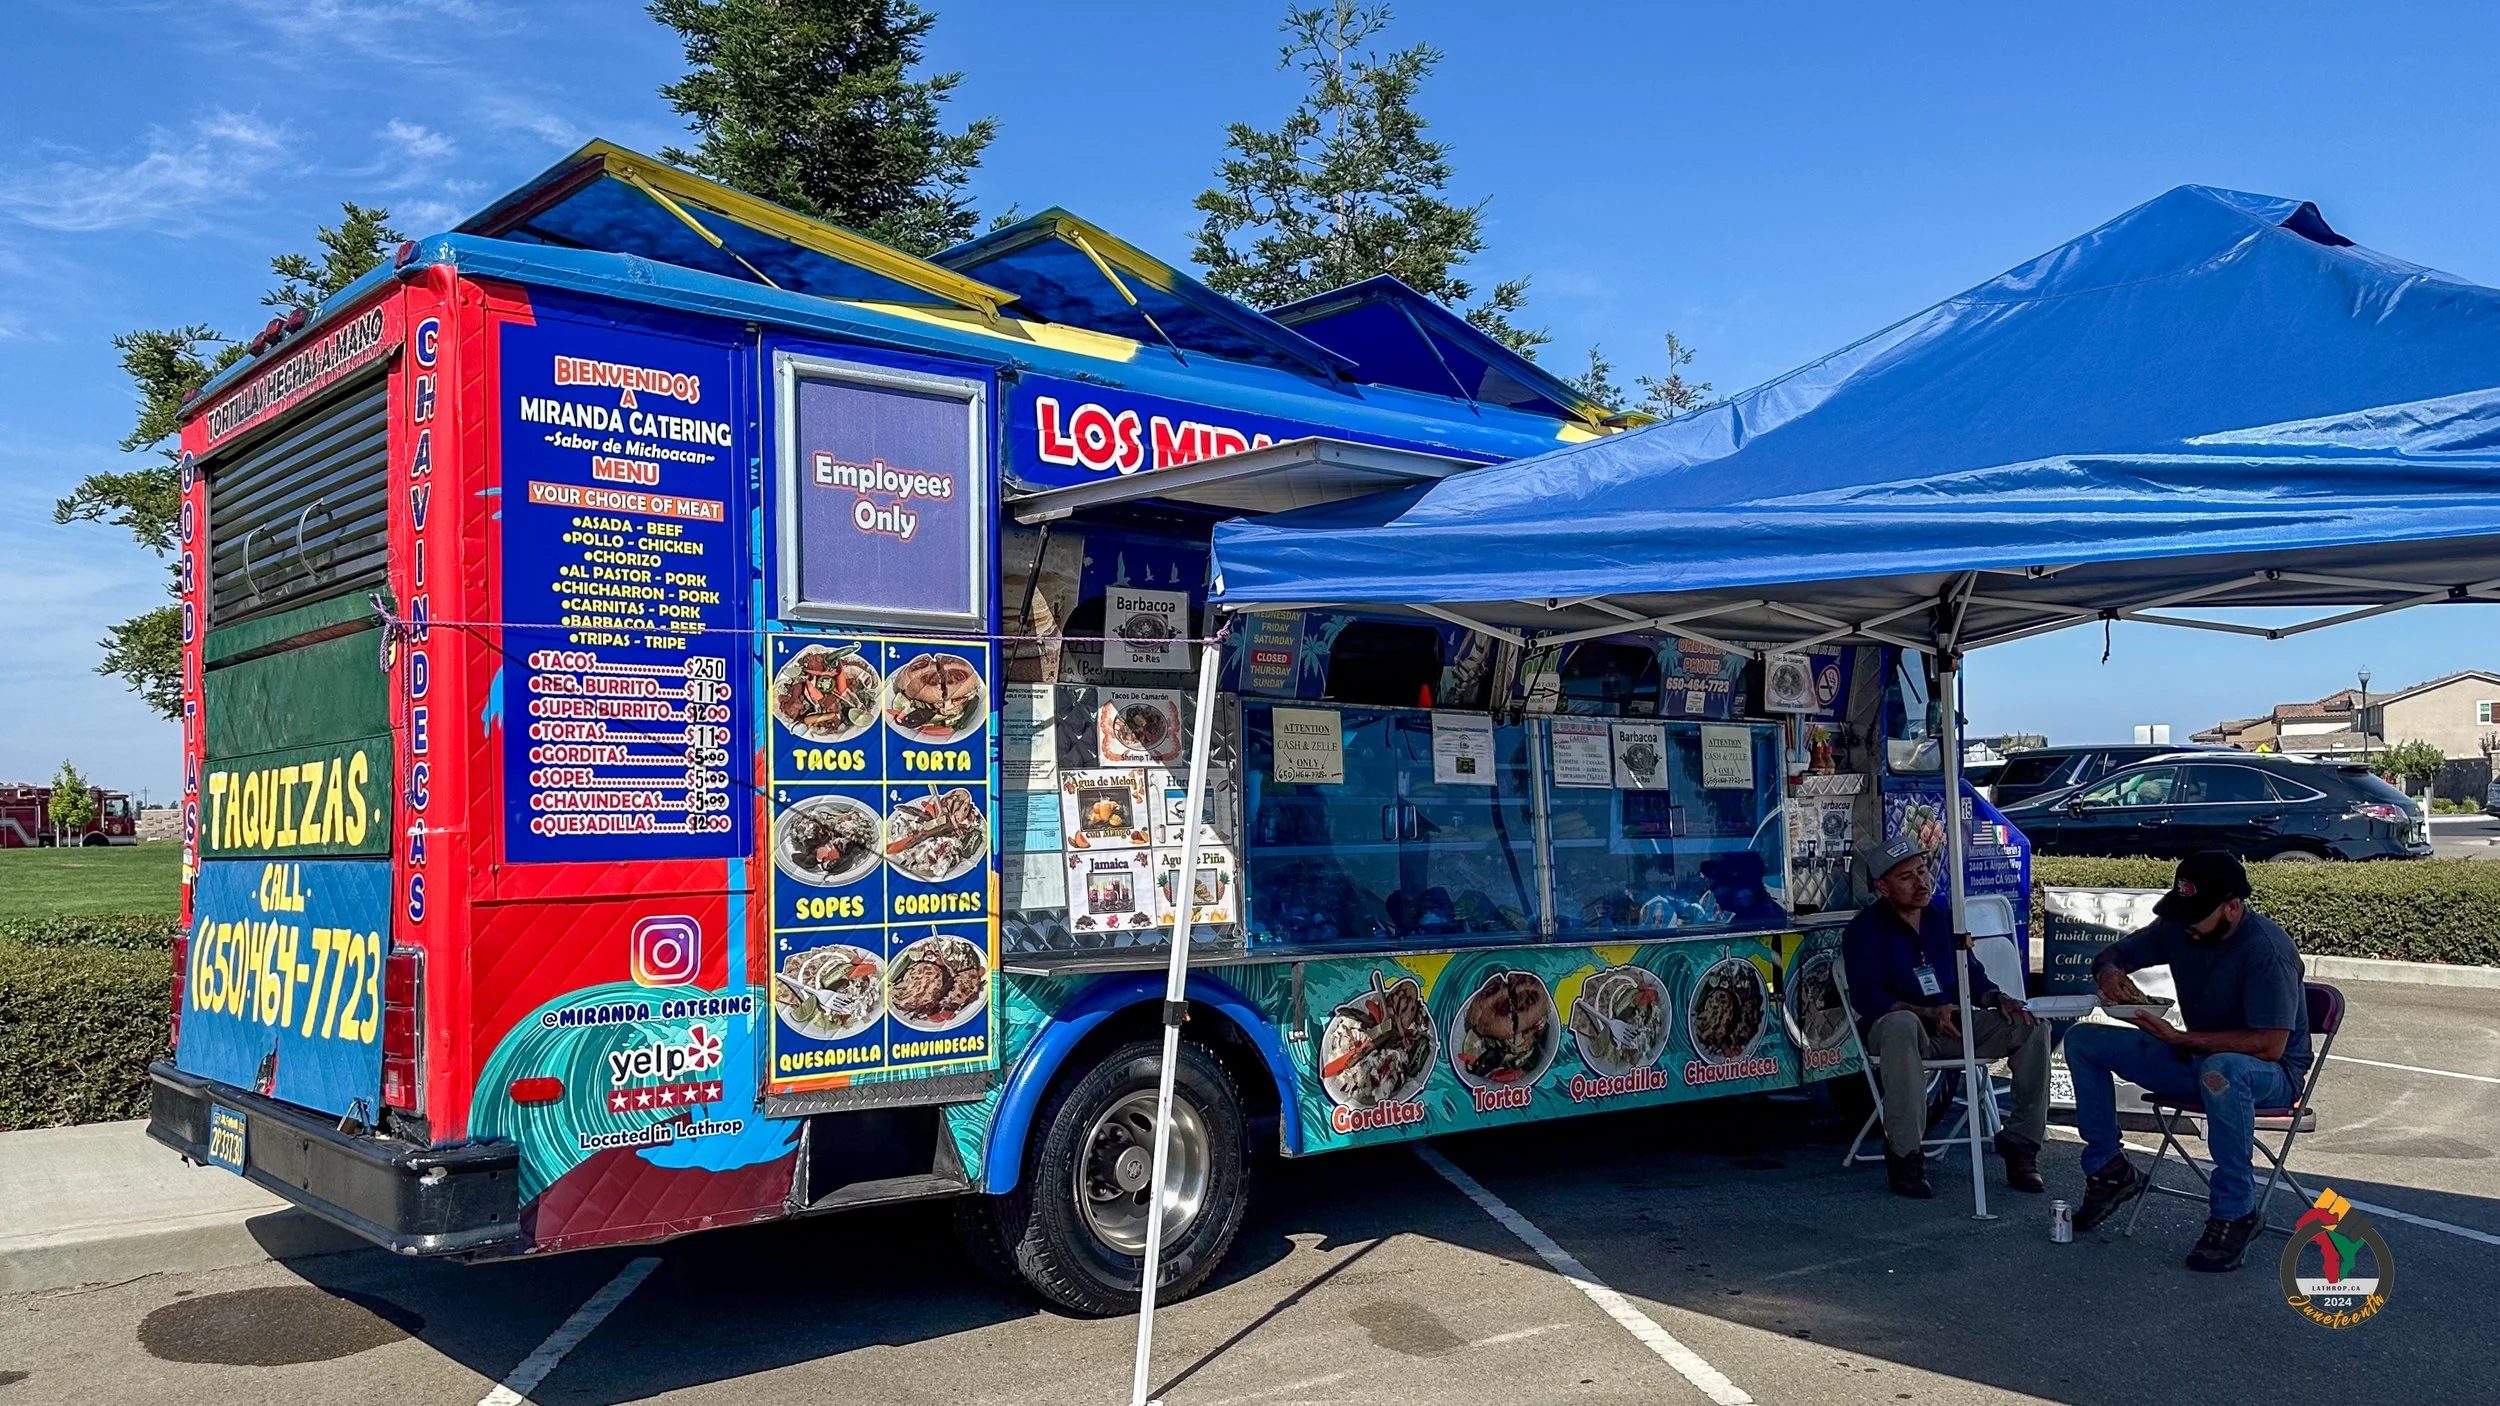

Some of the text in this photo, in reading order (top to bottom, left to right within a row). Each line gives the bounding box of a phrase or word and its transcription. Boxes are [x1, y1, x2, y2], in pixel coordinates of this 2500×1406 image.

[207, 381, 265, 443] TORTILLAS
[264, 344, 318, 405] HECHAS
[334, 305, 385, 366] MANO
[554, 355, 700, 405] BIENVENIDOS
[620, 388, 638, 409] A
[521, 396, 732, 447] MIRANDA CATERING
[1036, 395, 1144, 475] LOS
[602, 437, 622, 454] de
[592, 455, 660, 486] MENU
[814, 453, 952, 499] Employees
[532, 484, 720, 519] YOUR CHOICE OF MEAT
[582, 516, 683, 537] ASADA BEEF
[854, 501, 916, 538] Only
[571, 531, 704, 555] POLLO CHICKEN
[593, 551, 662, 568] CHORIZO
[568, 564, 707, 587] AL PASTOR PORK
[561, 580, 720, 604] CHICHARRON PORK
[571, 598, 701, 619] CARNITAS PORK
[1116, 596, 1176, 613] Barbacoa
[408, 316, 440, 923] CHAVINDECAS
[571, 615, 706, 635] BARBACOA BEEF
[1261, 622, 1290, 632] FRIDAY
[182, 450, 198, 846] GORDITAS
[579, 631, 687, 650] TRIPAS TRIPE
[777, 641, 789, 655] 1.
[1253, 634, 1295, 646] SATURDAY
[888, 645, 901, 659] 2.
[1132, 654, 1161, 664] De Res
[1257, 652, 1288, 663] CLOSED
[541, 652, 596, 670] TACOS
[1683, 657, 1720, 674] PHONE
[1250, 665, 1292, 676] THURSDAY
[541, 675, 581, 693] REG.
[585, 678, 659, 696] BURRITO
[1253, 678, 1285, 689] SUNDAY
[1666, 677, 1730, 693] 650-464-7723
[1111, 692, 1169, 701] Tacos De Camarón
[541, 699, 595, 718] SUPER
[598, 702, 671, 720] BURRITO
[541, 724, 607, 741] TORTAS
[1284, 723, 1330, 733] ATTENTION
[1277, 740, 1338, 751] CASH & ZELLE
[1619, 731, 1658, 743] Barbacoa
[1709, 738, 1742, 746] ATTENTION
[541, 747, 627, 764] GORDITAS
[793, 748, 866, 773] TACOS
[902, 749, 972, 773] TORTA
[1121, 753, 1144, 762] Shrimp
[1296, 759, 1319, 767] ONLY
[1704, 752, 1721, 760] CASH
[541, 770, 594, 786] SOPES
[1072, 776, 1097, 788] Agua
[1098, 776, 1109, 787] de
[208, 749, 368, 850] TAQUIZAS
[542, 793, 662, 811] CHAVINDECAS
[778, 790, 791, 803] 3.
[1821, 800, 1851, 810] arbacoa
[1962, 805, 1972, 819] 15
[543, 814, 656, 835] QUESADILLAS
[1086, 829, 1131, 839] con Mango
[1968, 845, 1996, 857] Miranda
[1089, 857, 1130, 872] Jamaica
[1162, 853, 1225, 868] Agu Piña
[1968, 861, 1984, 872] 2440
[2008, 858, 2022, 871] Way
[260, 862, 304, 913] CALL
[1970, 873, 2004, 887] Stockton CA
[796, 895, 865, 920] SOPES
[894, 891, 981, 916] GORDITAS
[779, 937, 793, 951] 5.
[890, 931, 903, 945] 6.
[2055, 929, 2119, 942] inside and
[2054, 953, 2081, 966] Call
[891, 1035, 985, 1060] CHAVINDECAS
[611, 1043, 686, 1082] yelp
[779, 1043, 882, 1073] QUESADILLA
[1803, 1047, 1842, 1070] Sopes
[1683, 1056, 1779, 1086] Chavindecas
[1569, 1065, 1668, 1103] Quesadillas
[1473, 1084, 1532, 1113] Tortas
[1331, 1099, 1425, 1134] Gorditas
[579, 1119, 743, 1150] Located in Lathrop
